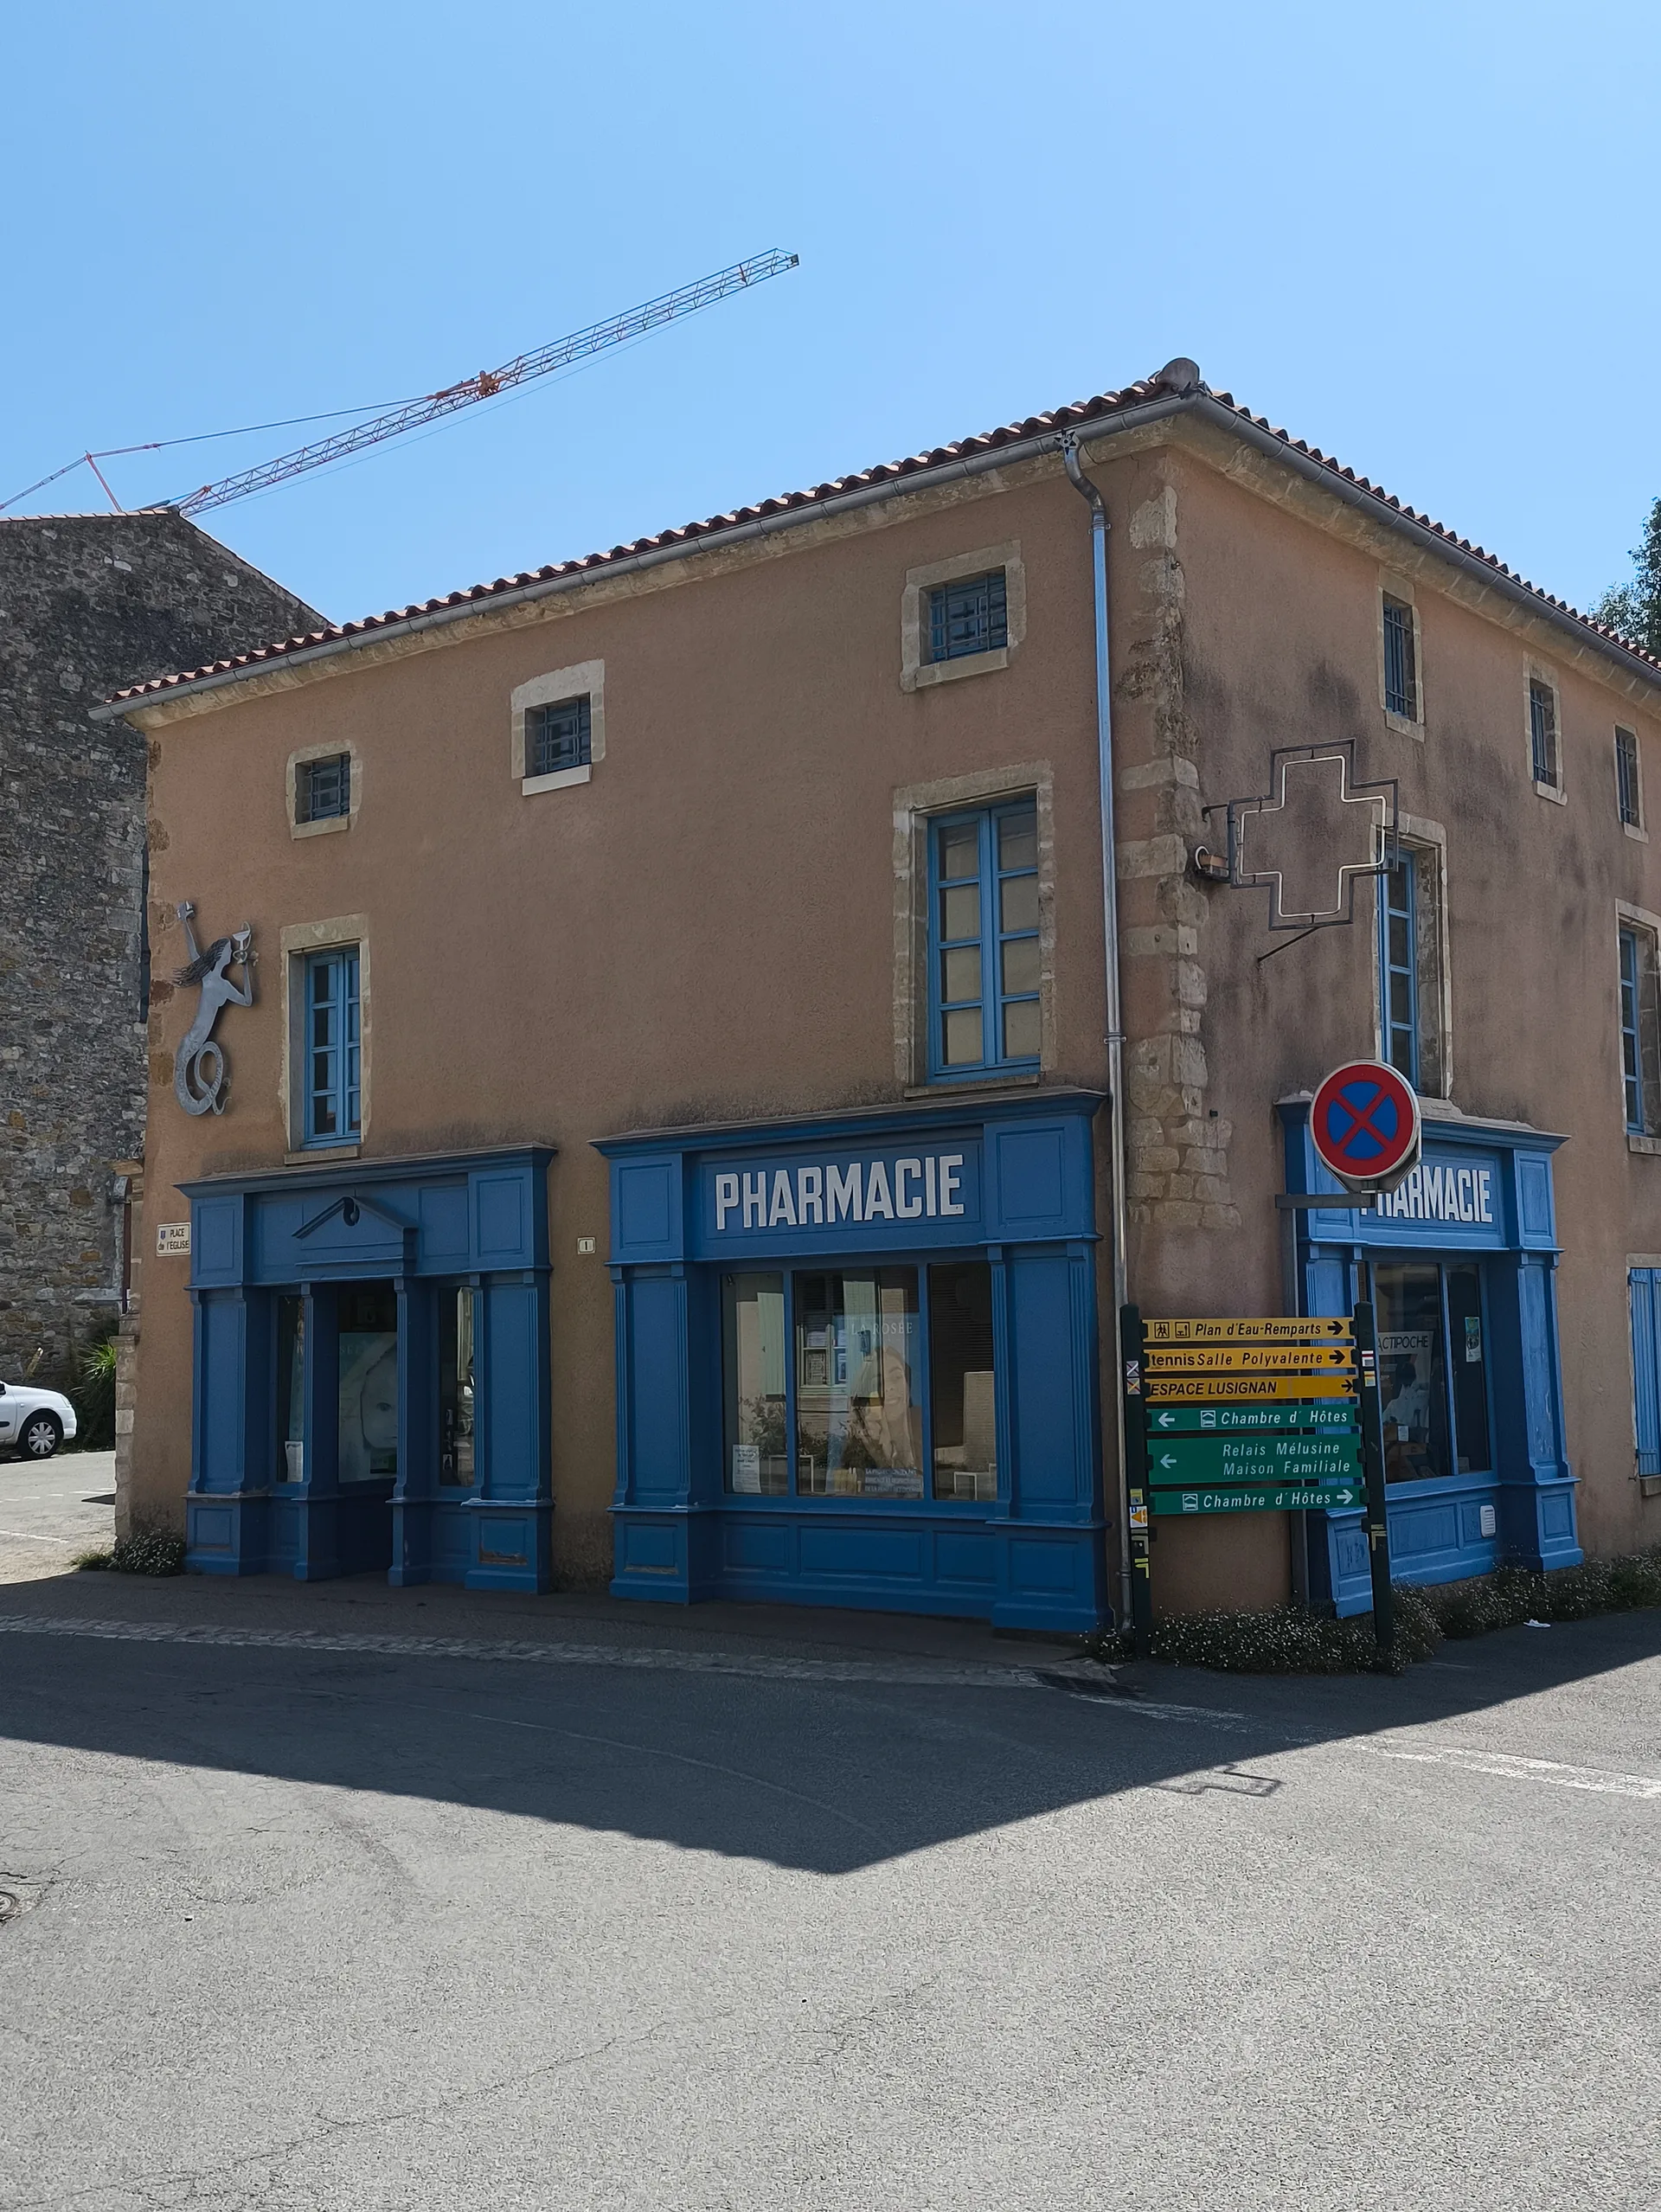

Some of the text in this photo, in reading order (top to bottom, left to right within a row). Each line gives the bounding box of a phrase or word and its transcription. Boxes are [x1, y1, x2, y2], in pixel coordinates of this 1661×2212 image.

[715, 1154, 965, 1230] PHARMACIE
[170, 1228, 185, 1238] PLACE
[1195, 1323, 1321, 1337] Plan d'Eau-Remparts
[1151, 1352, 1324, 1367] tennis Salle Polyvalente
[1150, 1382, 1277, 1396] ESPACE LUSIGNAN
[1221, 1412, 1281, 1424] Chambre
[1310, 1410, 1348, 1422] Hôtes
[1222, 1443, 1340, 1457] Relais Mélusine
[1223, 1460, 1350, 1476] Maison Familiale
[1203, 1495, 1266, 1509] Chambre
